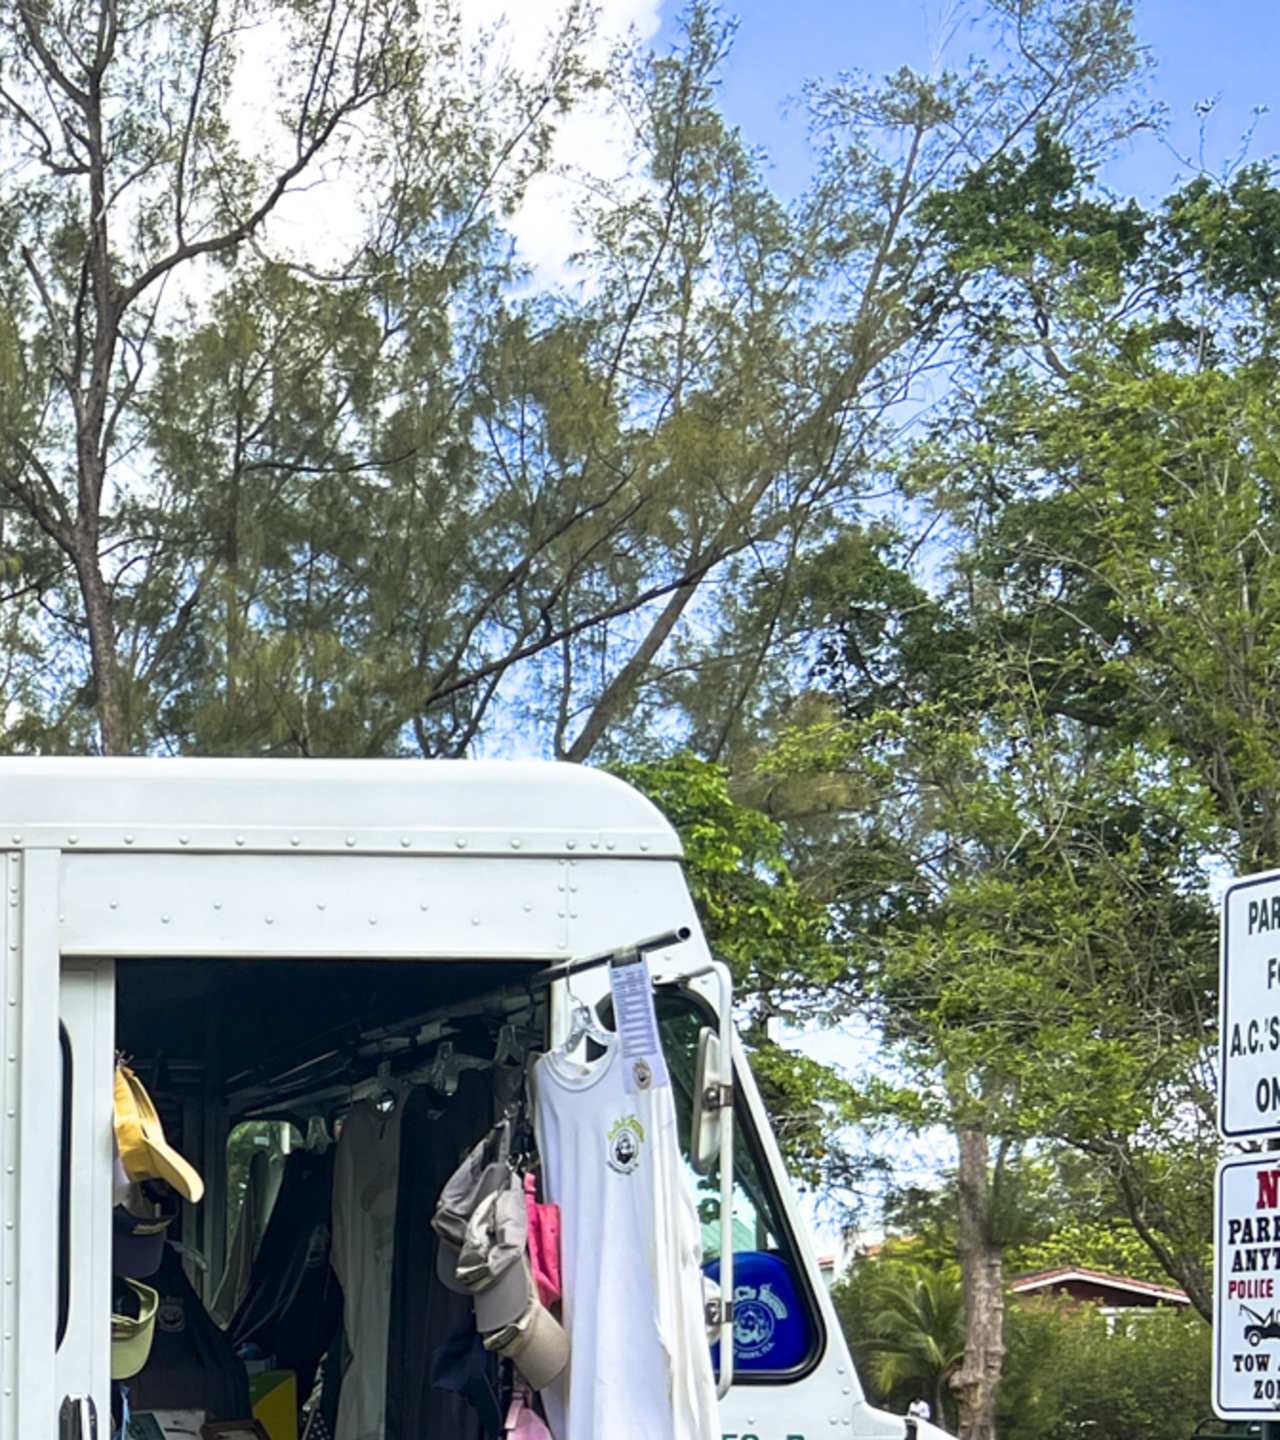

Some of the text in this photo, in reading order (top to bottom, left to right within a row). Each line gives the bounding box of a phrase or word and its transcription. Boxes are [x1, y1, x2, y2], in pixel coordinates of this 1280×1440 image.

[1248, 896, 1280, 936] PAR
[1256, 1169, 1280, 1210] N
[1228, 1279, 1273, 1299] POLICE
[1233, 1354, 1270, 1373] TOW
